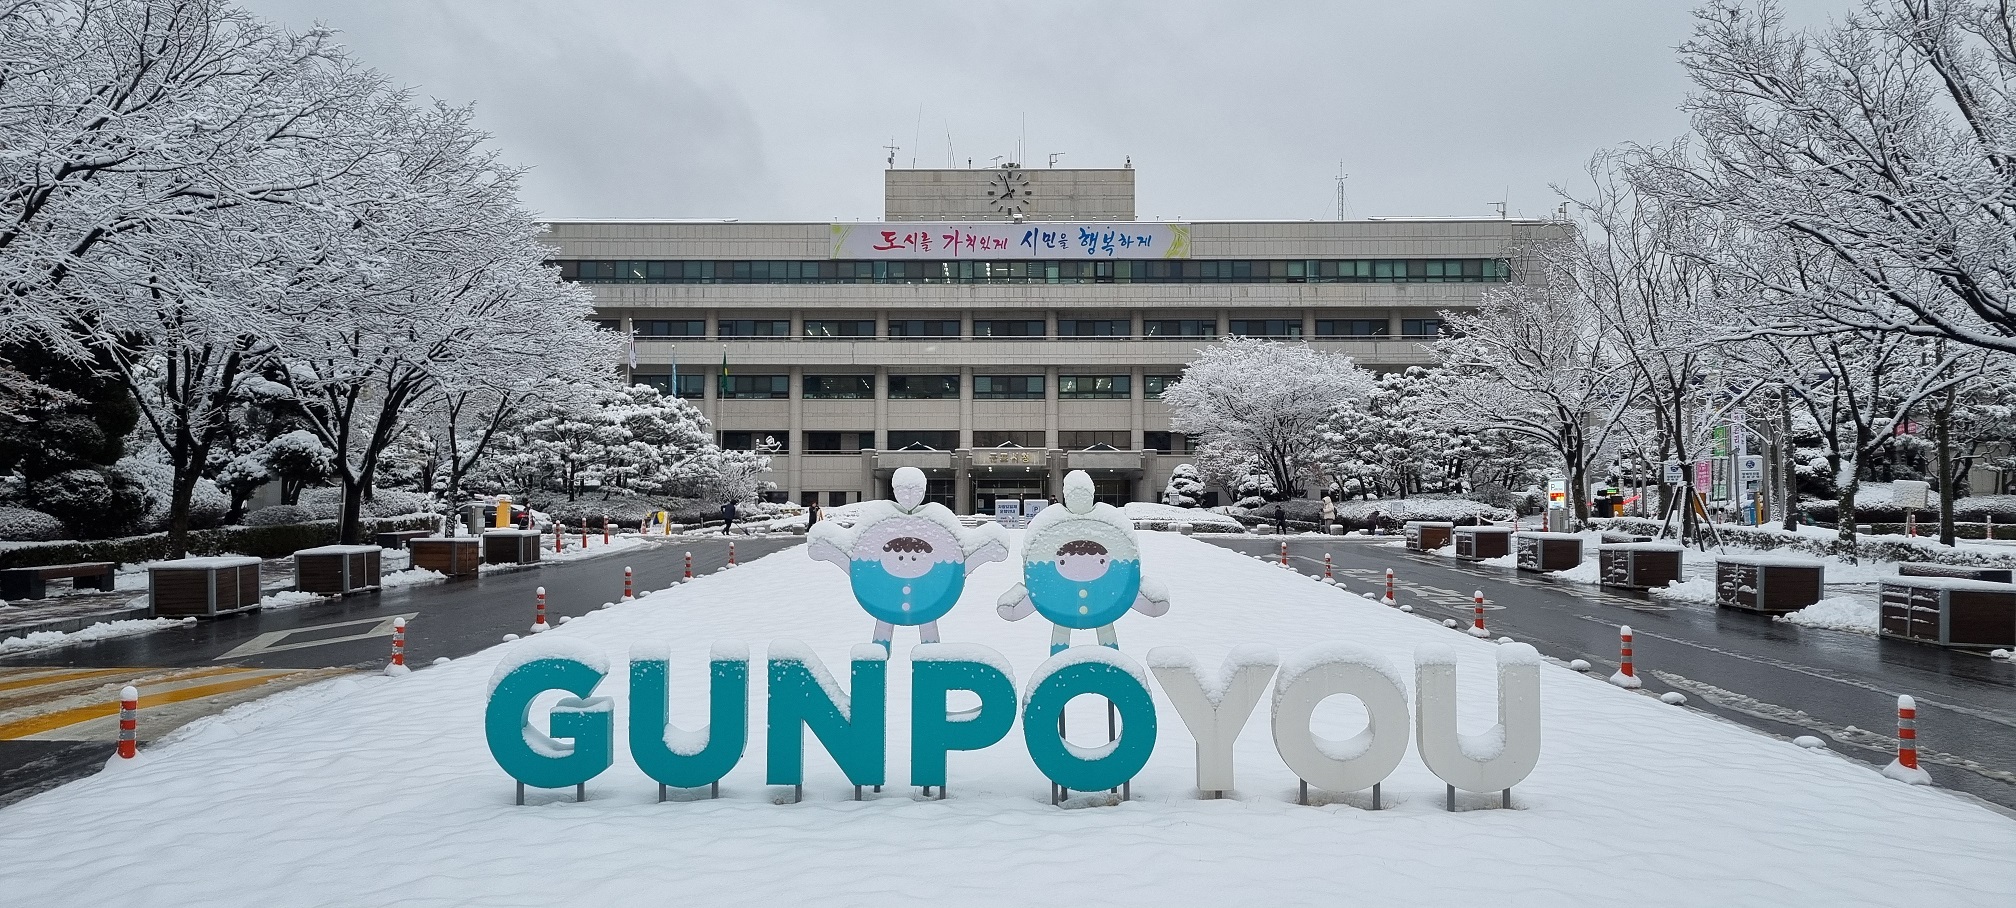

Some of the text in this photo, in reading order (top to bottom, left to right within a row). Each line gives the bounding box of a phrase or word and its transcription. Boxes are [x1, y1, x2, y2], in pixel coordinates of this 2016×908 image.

[873, 226, 1152, 257] 도시를 가치있게 시민을 행복하게
